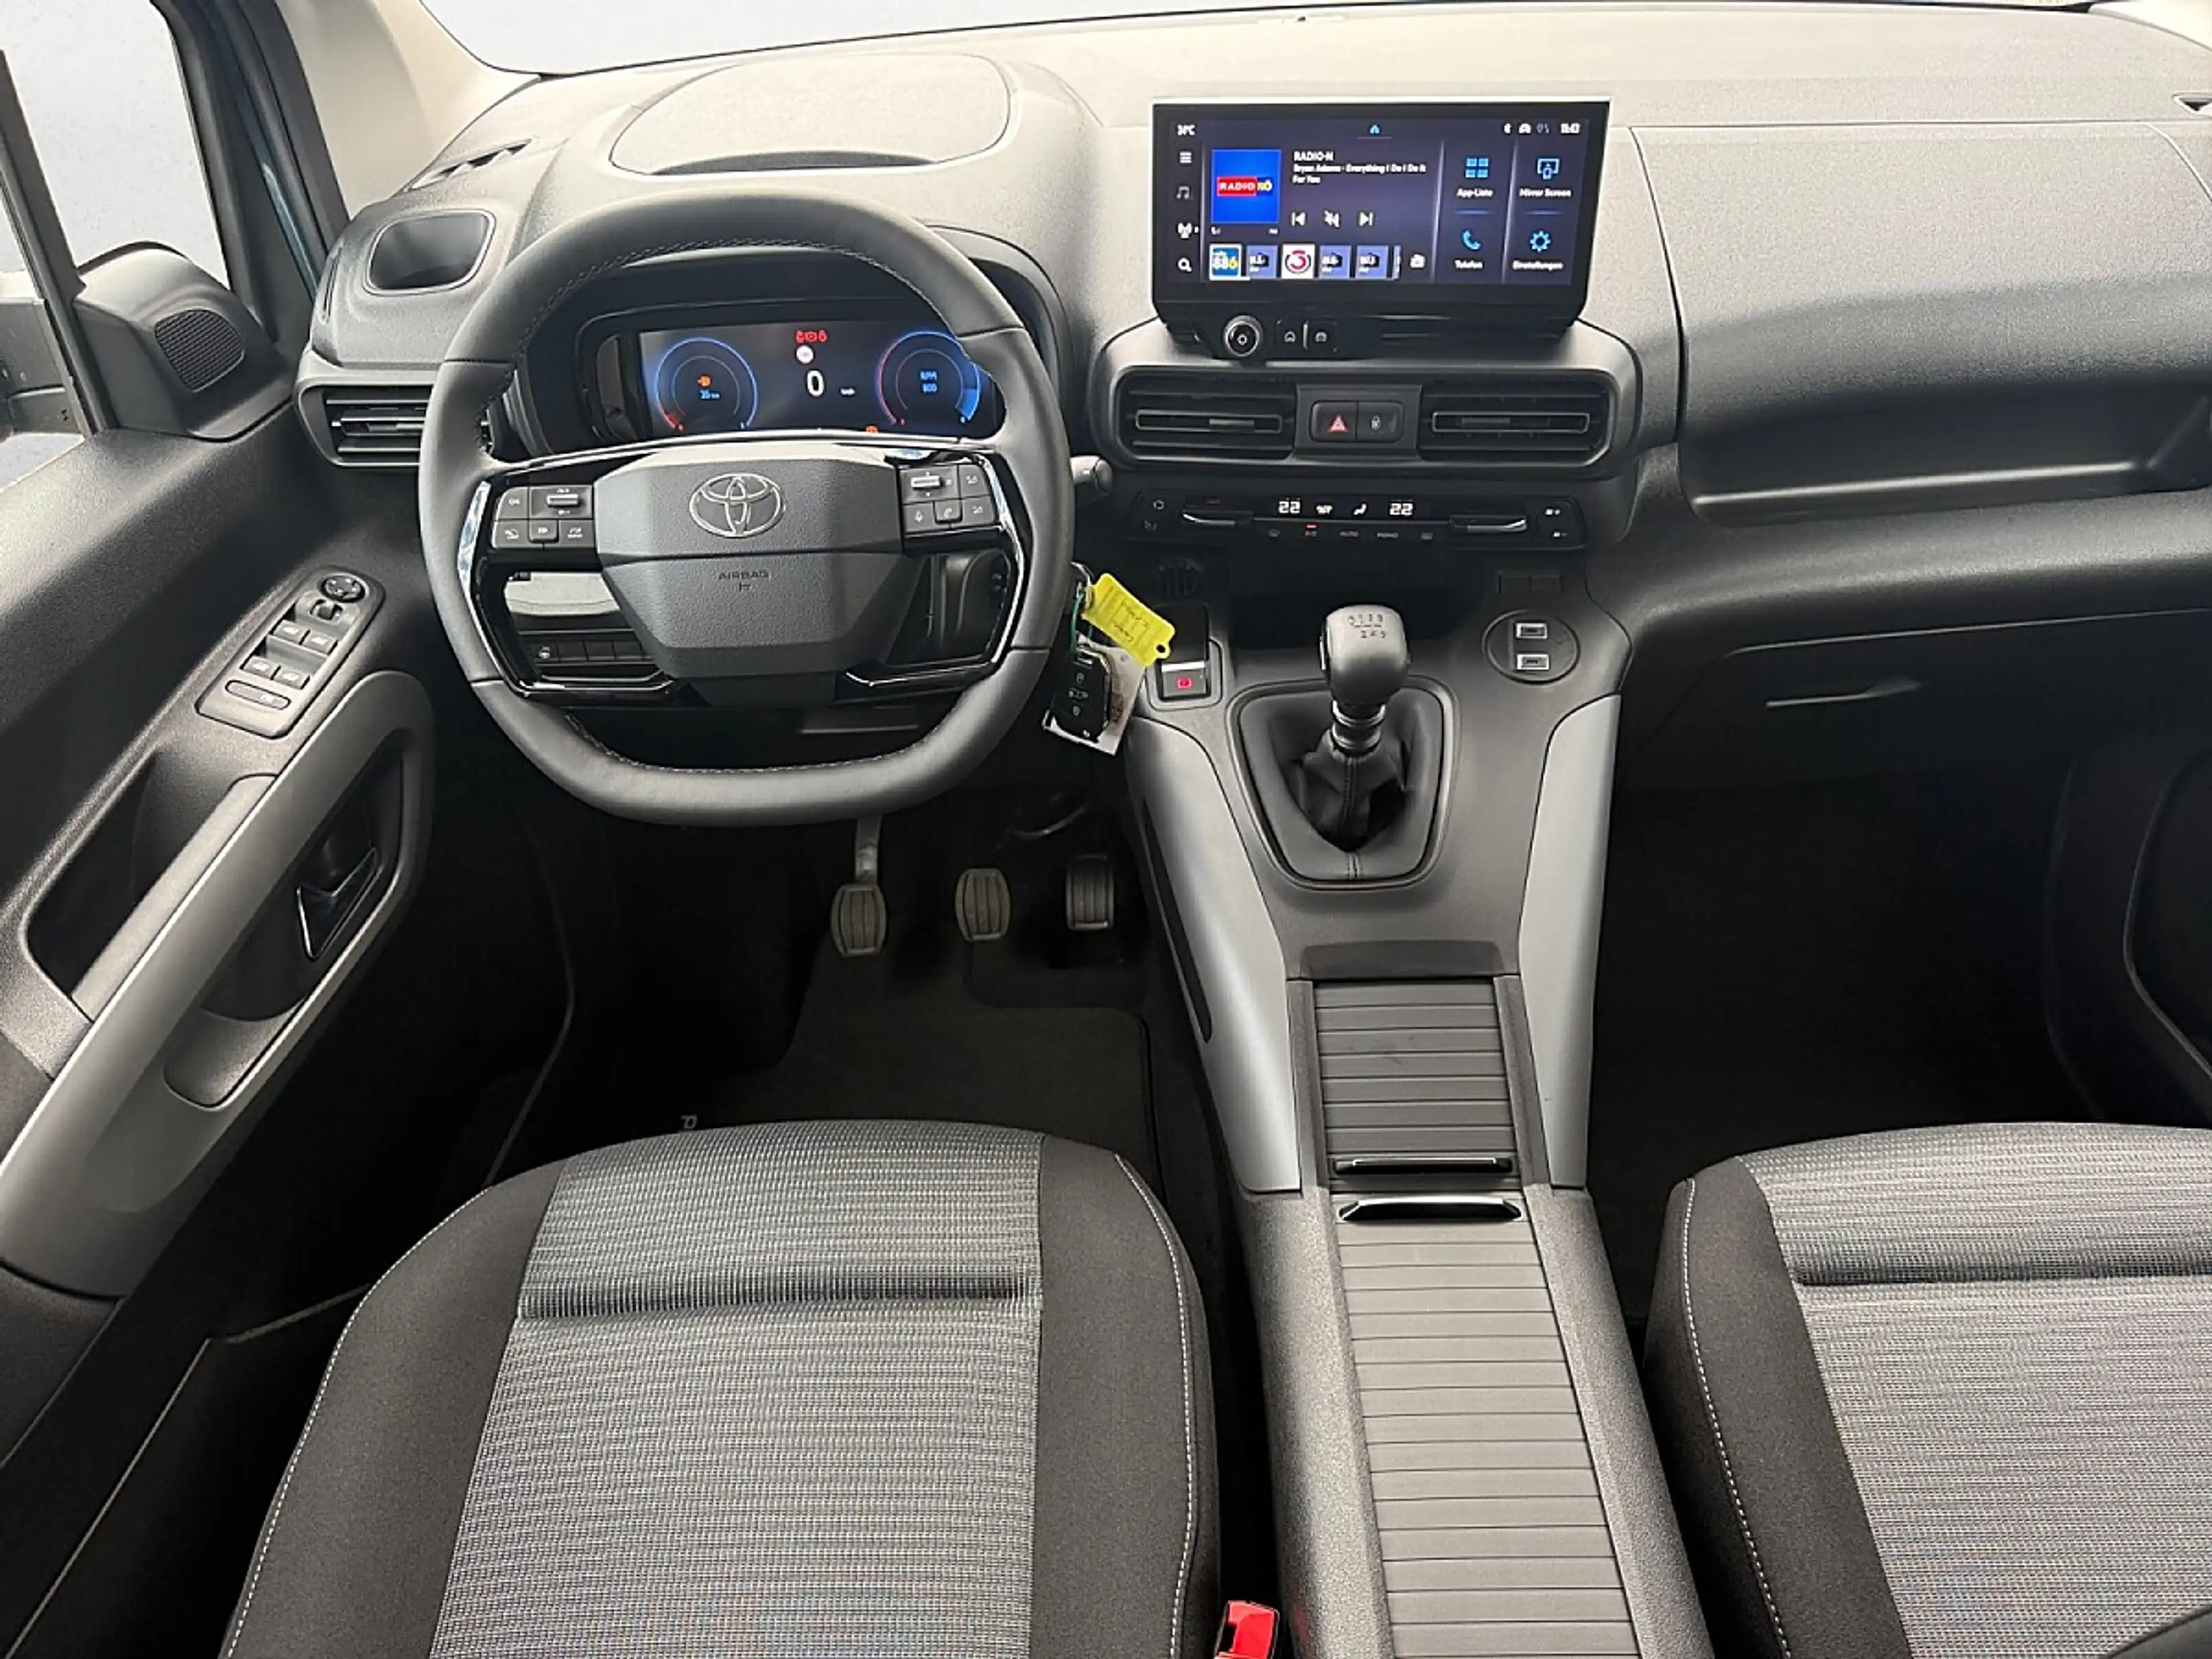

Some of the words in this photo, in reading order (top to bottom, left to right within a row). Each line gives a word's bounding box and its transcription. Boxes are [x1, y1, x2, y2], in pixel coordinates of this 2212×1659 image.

[1219, 181, 1256, 191] RADIO
[806, 369, 824, 397] 0
[1278, 501, 1300, 514] 22
[1390, 503, 1413, 516] 22
